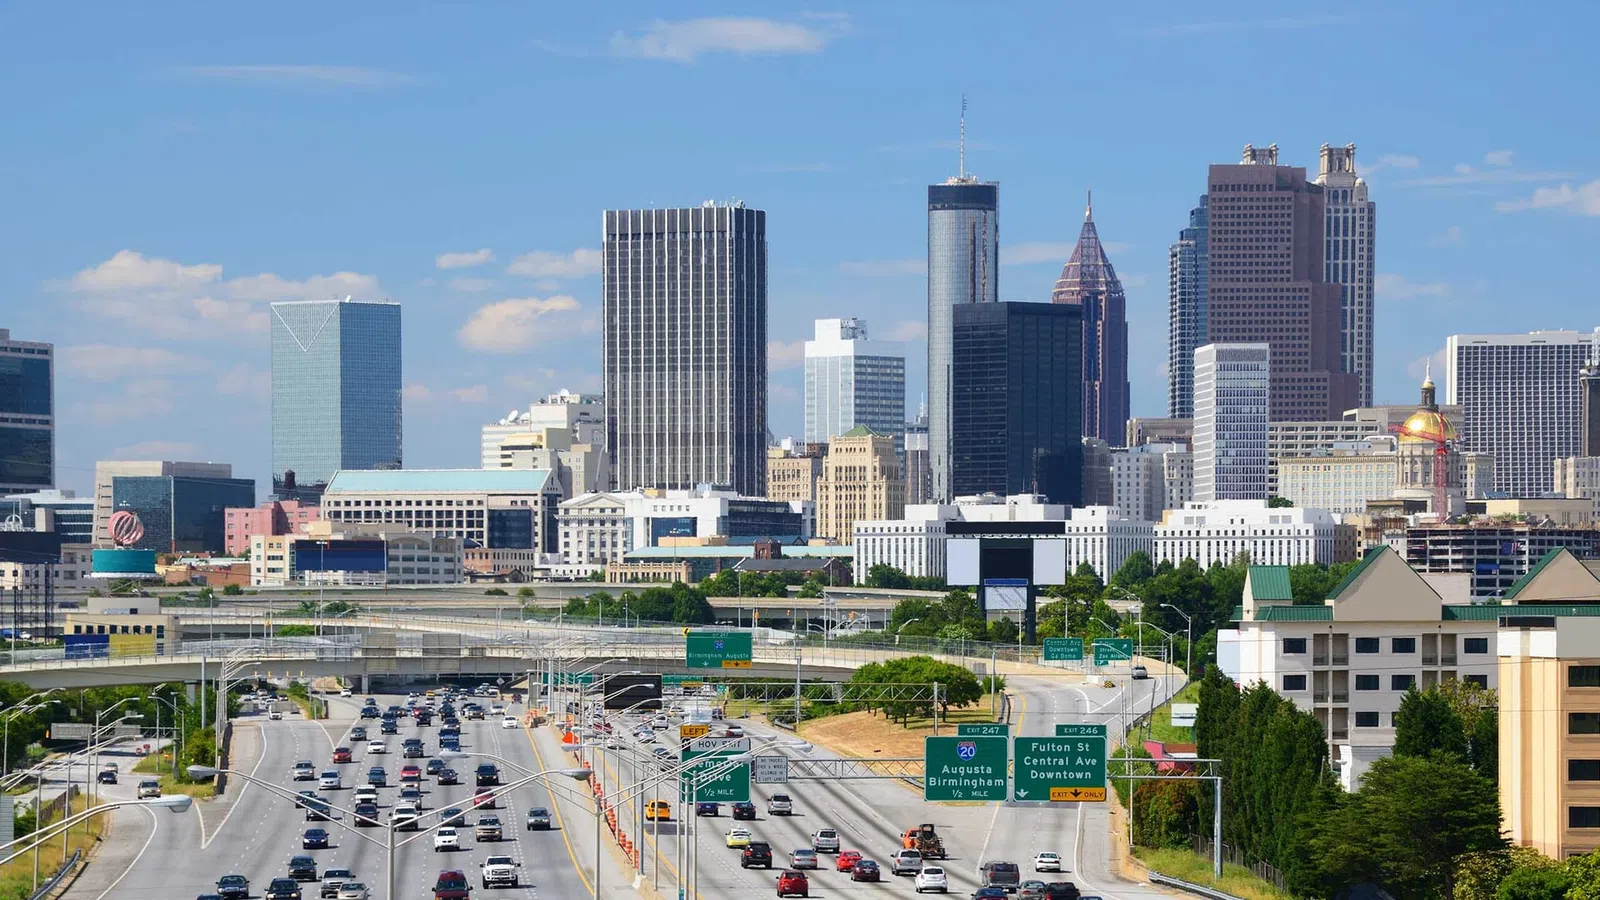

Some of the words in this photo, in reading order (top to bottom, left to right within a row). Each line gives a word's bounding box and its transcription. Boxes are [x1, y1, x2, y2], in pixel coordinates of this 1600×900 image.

[683, 727, 705, 735] LEFT
[982, 726, 1000, 734] 247
[698, 740, 717, 748] HOV
[1031, 743, 1071, 752] Fulton
[1077, 743, 1090, 752] St
[960, 746, 975, 757] 20
[1024, 756, 1069, 766] Central
[1075, 757, 1097, 766] Ave
[942, 765, 992, 776] Augusta
[1030, 770, 1091, 779] Downtown
[929, 777, 1004, 789] Birmingham
